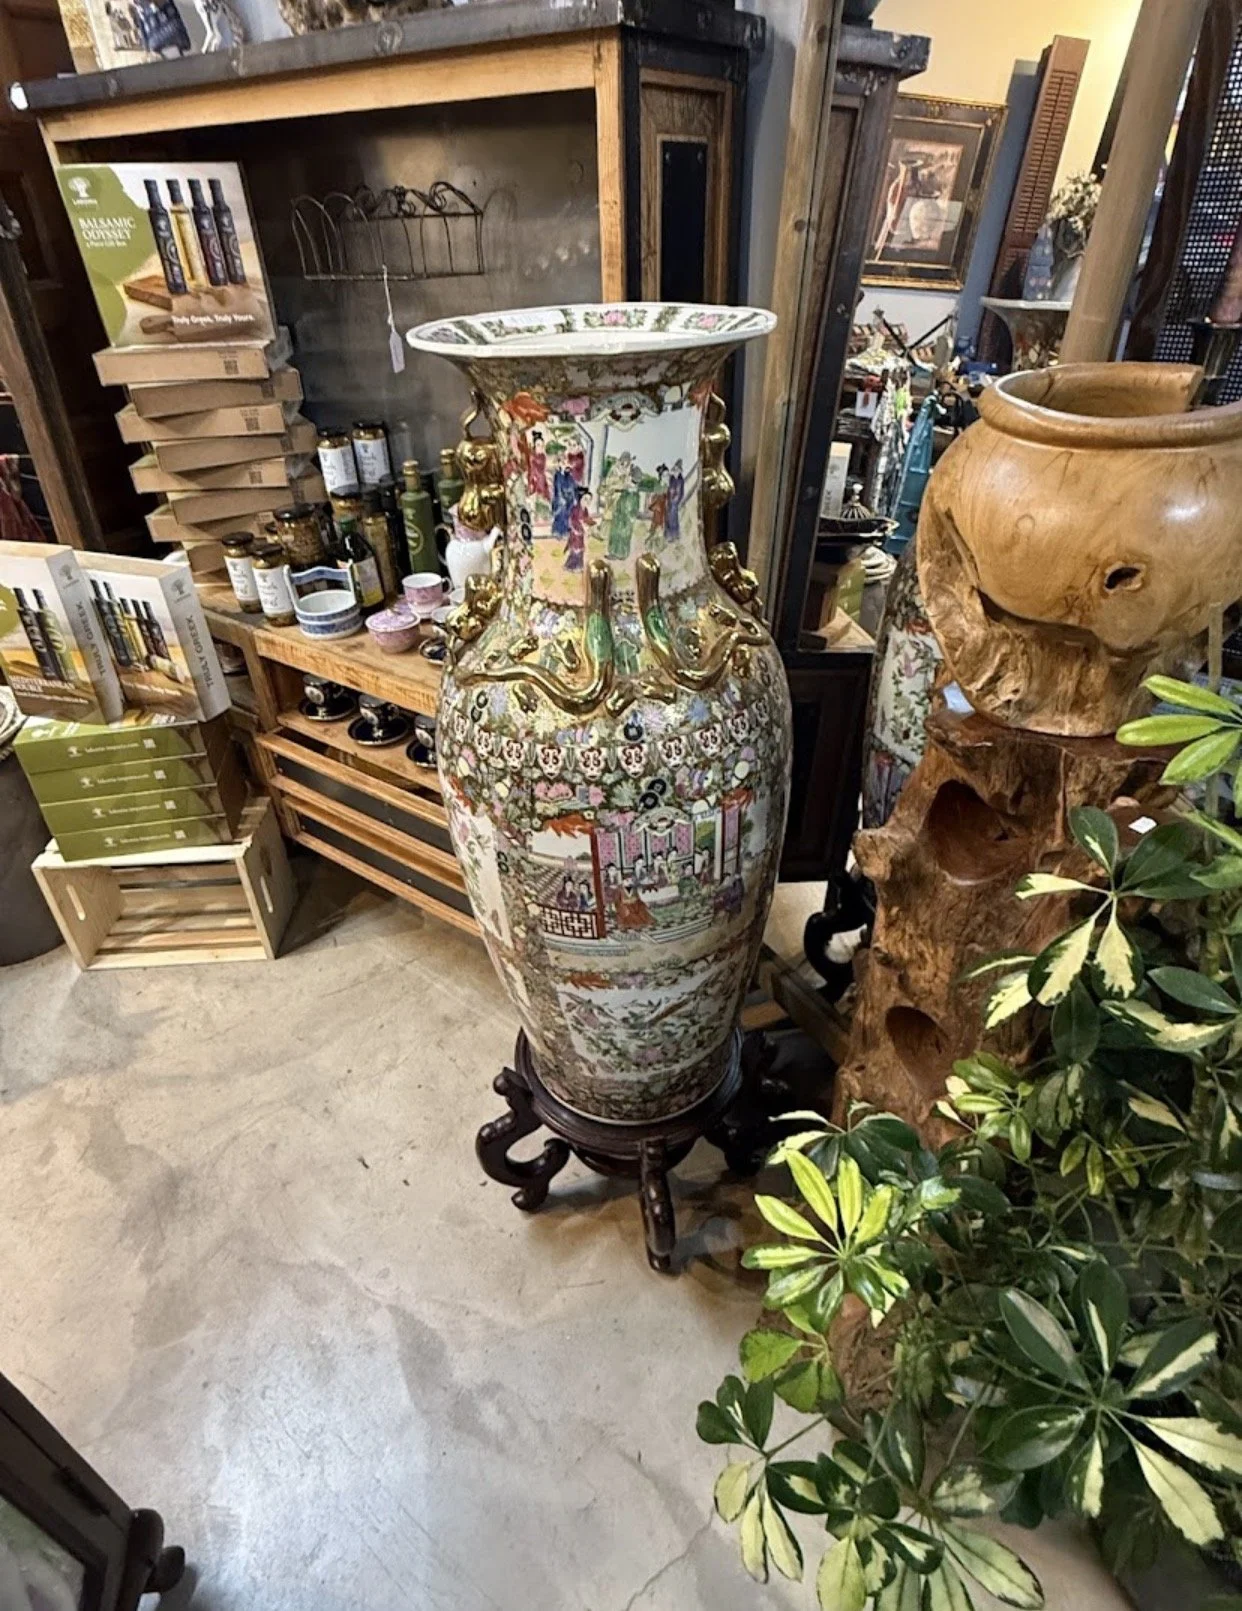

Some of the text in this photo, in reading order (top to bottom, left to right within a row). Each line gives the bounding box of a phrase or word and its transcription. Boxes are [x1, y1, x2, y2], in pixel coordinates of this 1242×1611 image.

[78, 217, 136, 231] BALSAMIC
[82, 229, 131, 241] ODYSSEY
[171, 315, 190, 325] Truly
[214, 314, 232, 324] Truly
[75, 601, 106, 676] TRULY GREEK
[186, 615, 214, 688] TRULY GREEK
